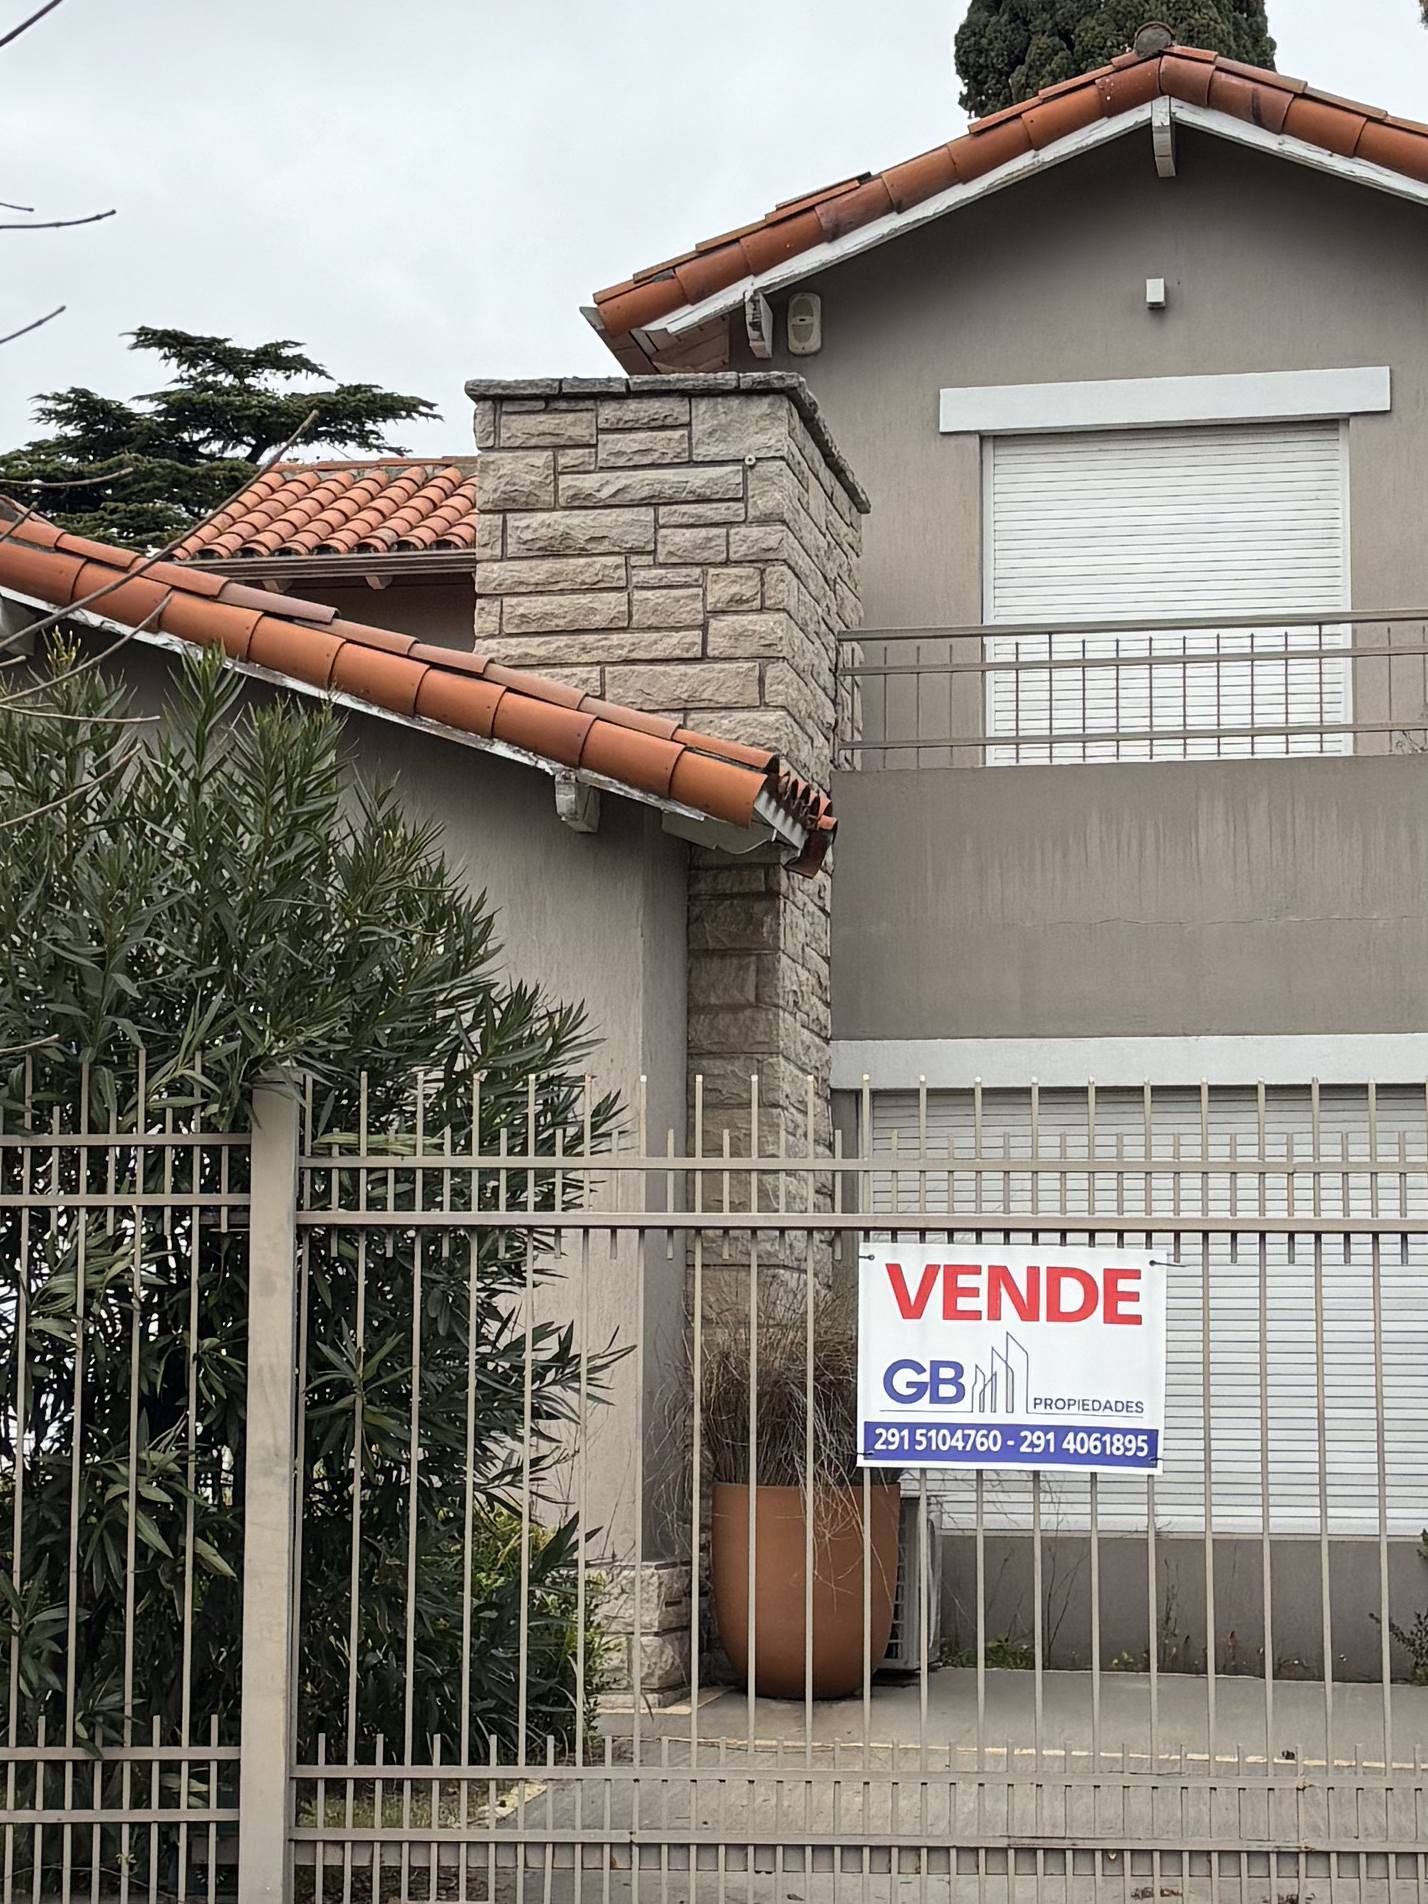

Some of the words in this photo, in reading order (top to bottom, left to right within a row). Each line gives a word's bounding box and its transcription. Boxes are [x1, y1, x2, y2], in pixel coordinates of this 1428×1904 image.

[885, 1263, 1143, 1325] VENDE
[882, 1358, 966, 1405] GB
[1033, 1397, 1145, 1414] PROPIEDADES
[874, 1427, 909, 1451] 291
[914, 1428, 1002, 1452] 5104760
[1019, 1431, 1055, 1453] 291
[1061, 1432, 1149, 1457] 4061895
